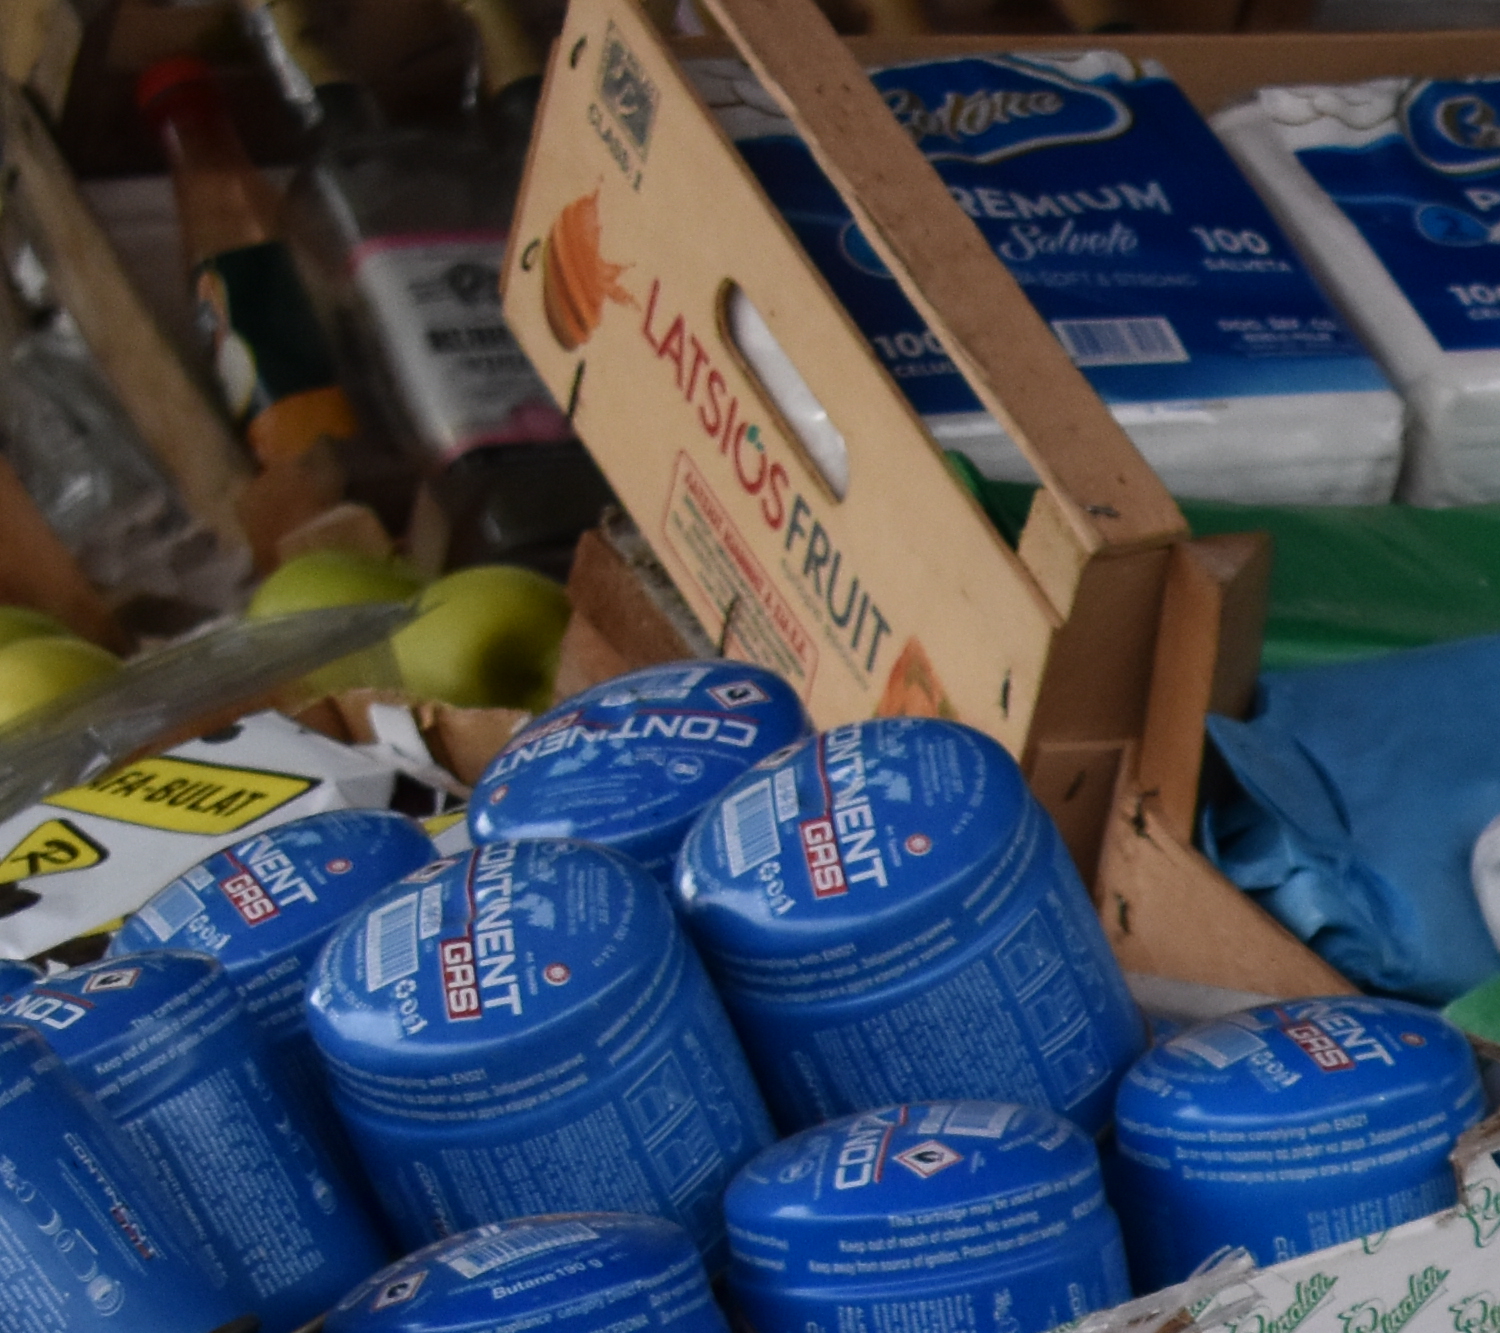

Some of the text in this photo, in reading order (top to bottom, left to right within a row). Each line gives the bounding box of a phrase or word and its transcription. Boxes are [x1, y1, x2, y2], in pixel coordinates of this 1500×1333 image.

[948, 180, 1174, 220] REMIUM
[1191, 226, 1270, 255] 100
[641, 278, 789, 530] LATSIOS
[784, 493, 892, 673] FRUIT
[11, 838, 80, 875] R
[804, 821, 846, 892] GAS
[223, 873, 276, 922] GAS
[444, 941, 479, 1013] GAS
[1289, 1026, 1350, 1068] GAS
[491, 1271, 557, 1300] Butane
